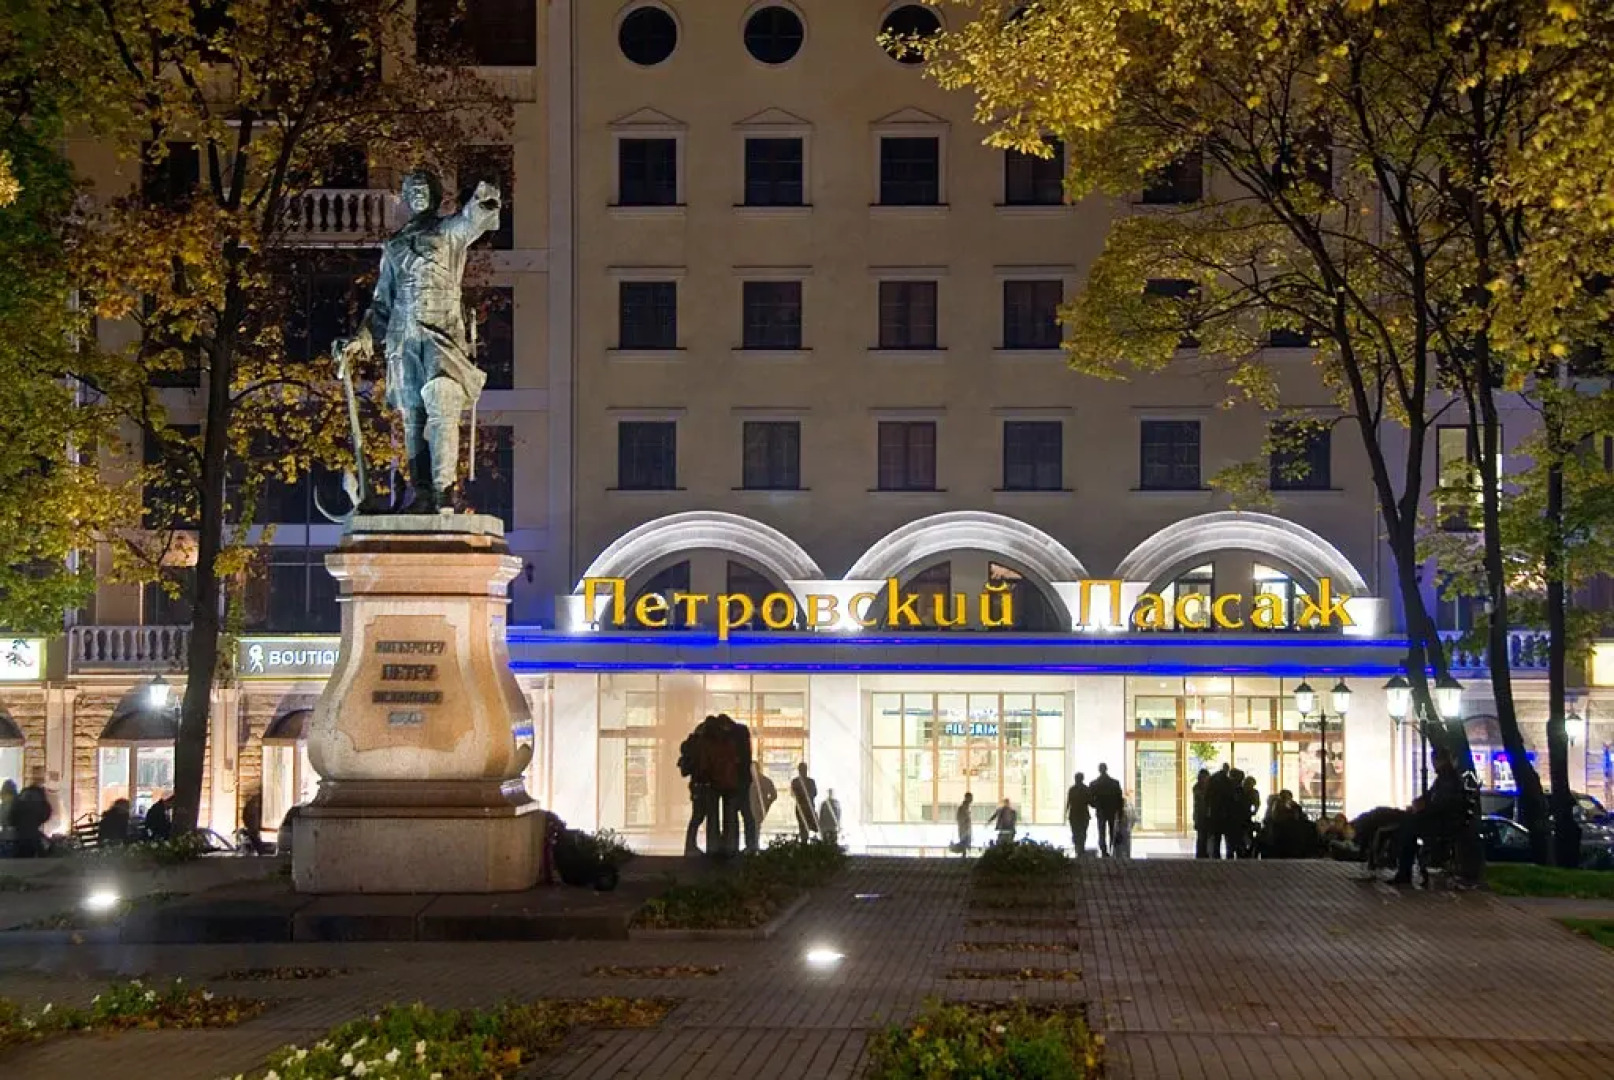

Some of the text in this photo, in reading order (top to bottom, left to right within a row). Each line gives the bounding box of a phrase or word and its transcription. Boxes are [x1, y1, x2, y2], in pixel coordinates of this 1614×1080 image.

[583, 576, 1357, 641] Петровский Пассаж
[945, 722, 999, 735] PILGRIM
